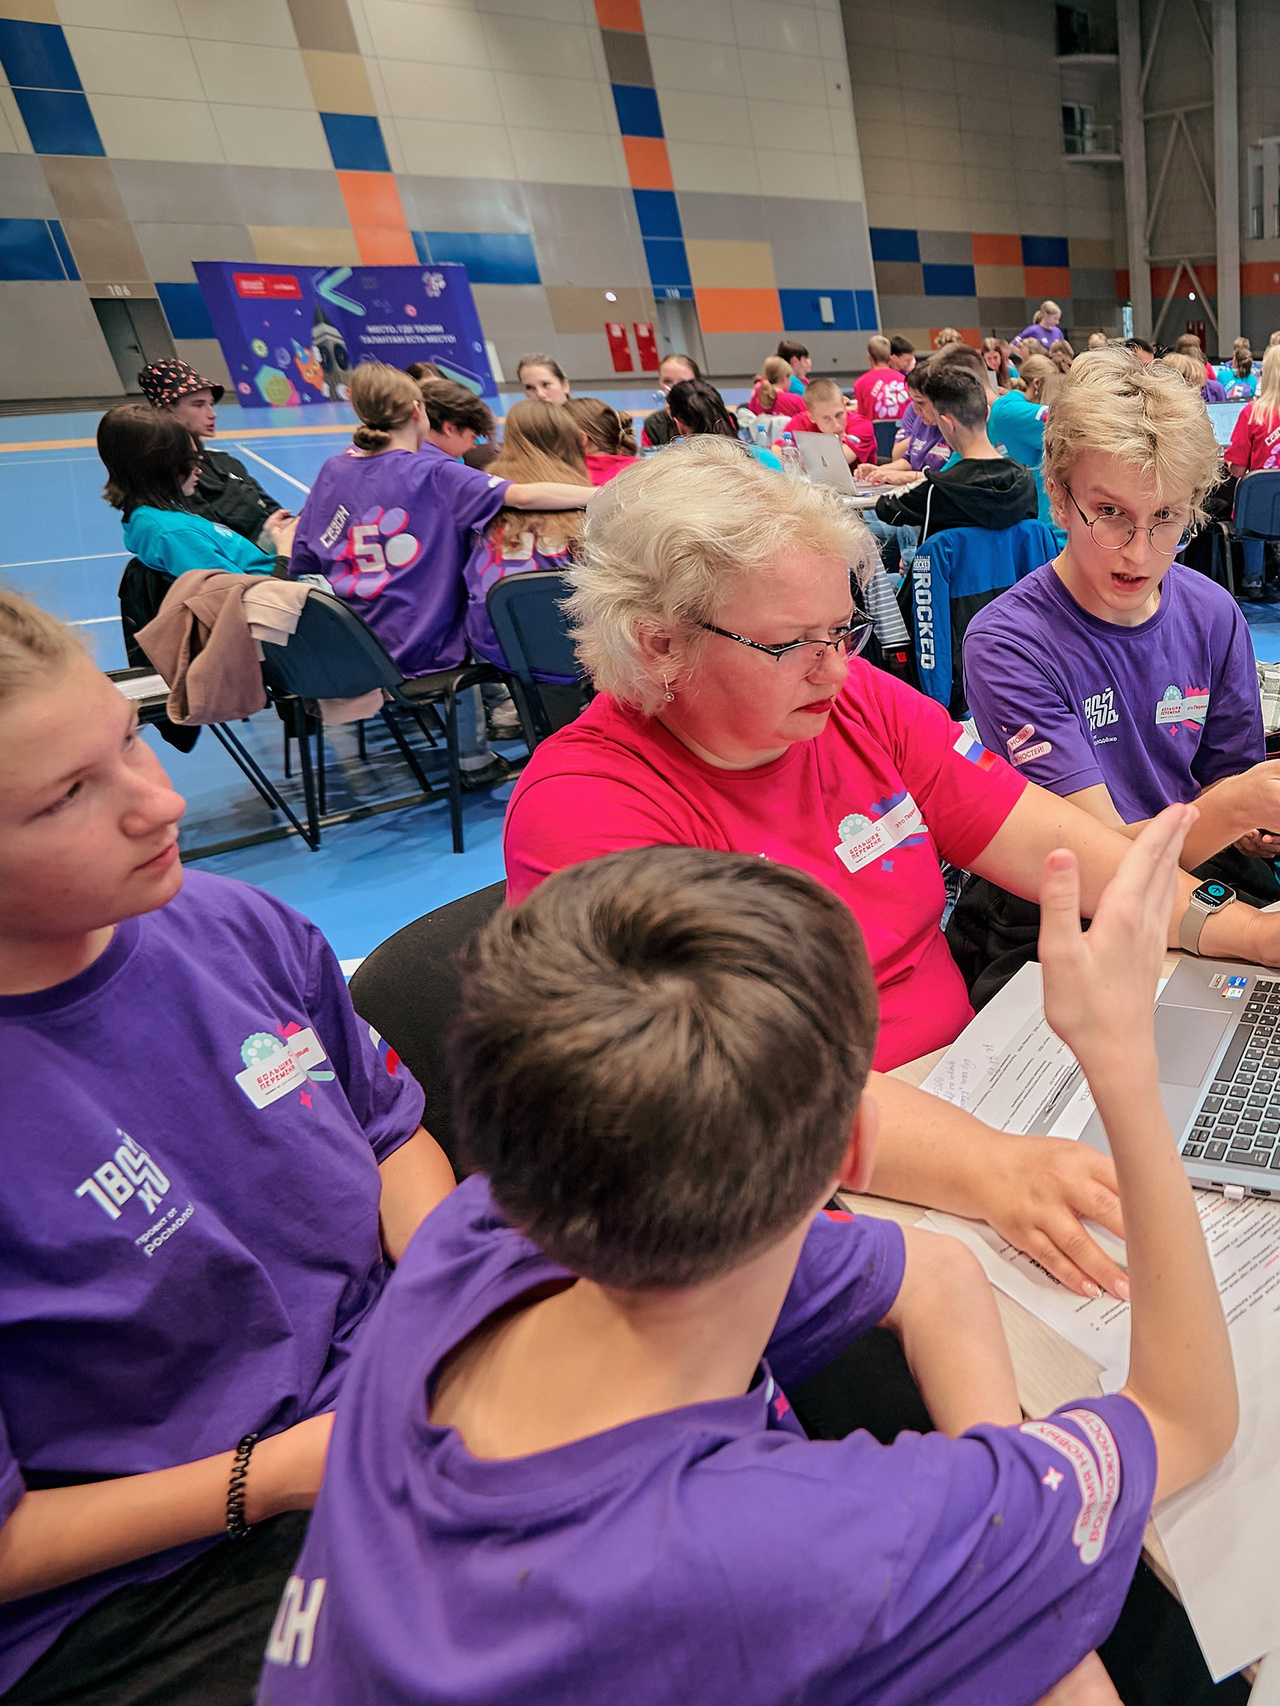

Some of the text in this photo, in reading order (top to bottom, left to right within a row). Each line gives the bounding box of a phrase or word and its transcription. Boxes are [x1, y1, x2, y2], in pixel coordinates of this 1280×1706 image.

[354, 525, 386, 572] 5
[913, 573, 935, 669] ROCKED
[849, 833, 880, 855] БОЛЬШАЯ
[851, 838, 882, 860] ПЕРЕМЕНА
[256, 1058, 293, 1084] БОЛЬШАЯ
[1038, 1425, 1090, 1468] НОВЫХ
